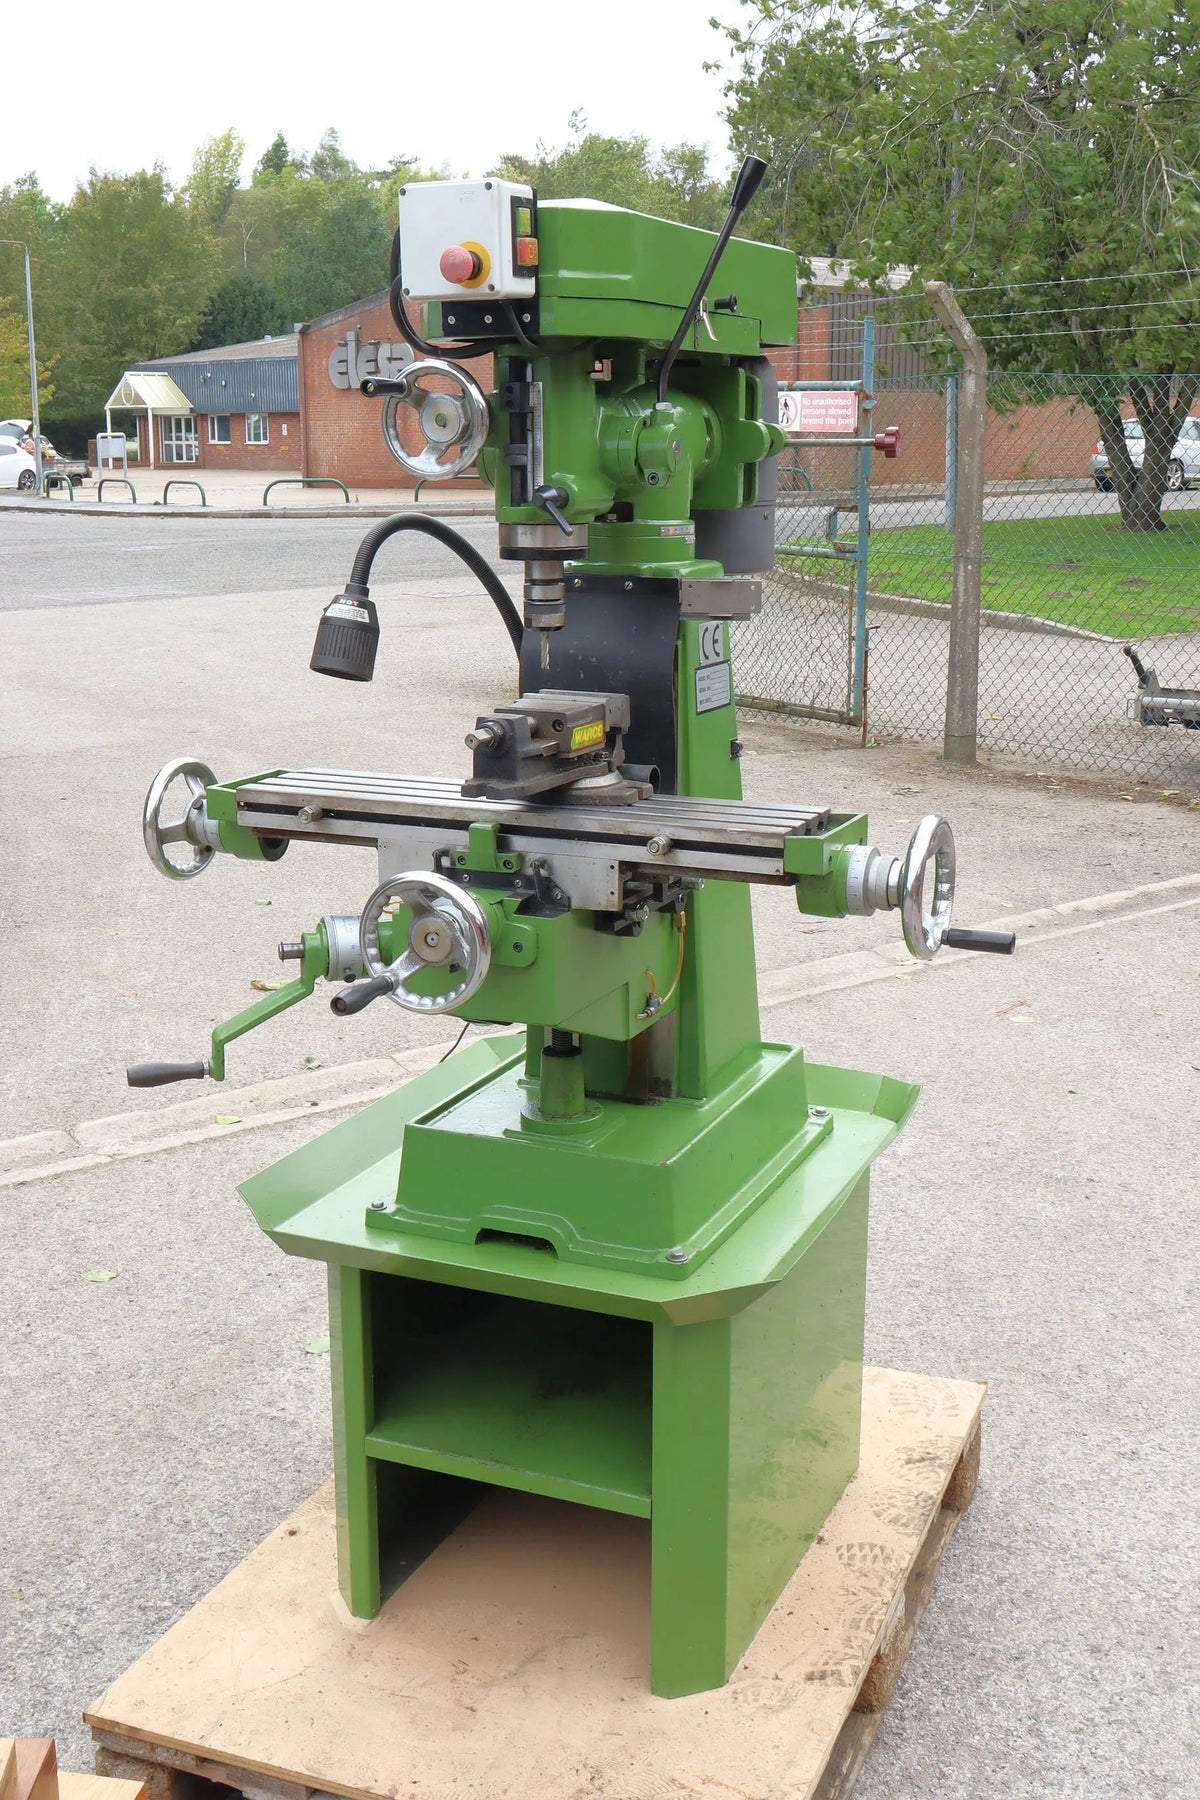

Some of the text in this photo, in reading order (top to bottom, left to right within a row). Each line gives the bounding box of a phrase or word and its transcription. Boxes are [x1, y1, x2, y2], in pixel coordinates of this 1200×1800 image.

[802, 409, 826, 417] persons
[801, 418, 824, 426] beyond
[838, 418, 854, 426] point
[339, 598, 359, 606] HOT
[702, 624, 720, 660] CE
[575, 723, 603, 743] WARCO
